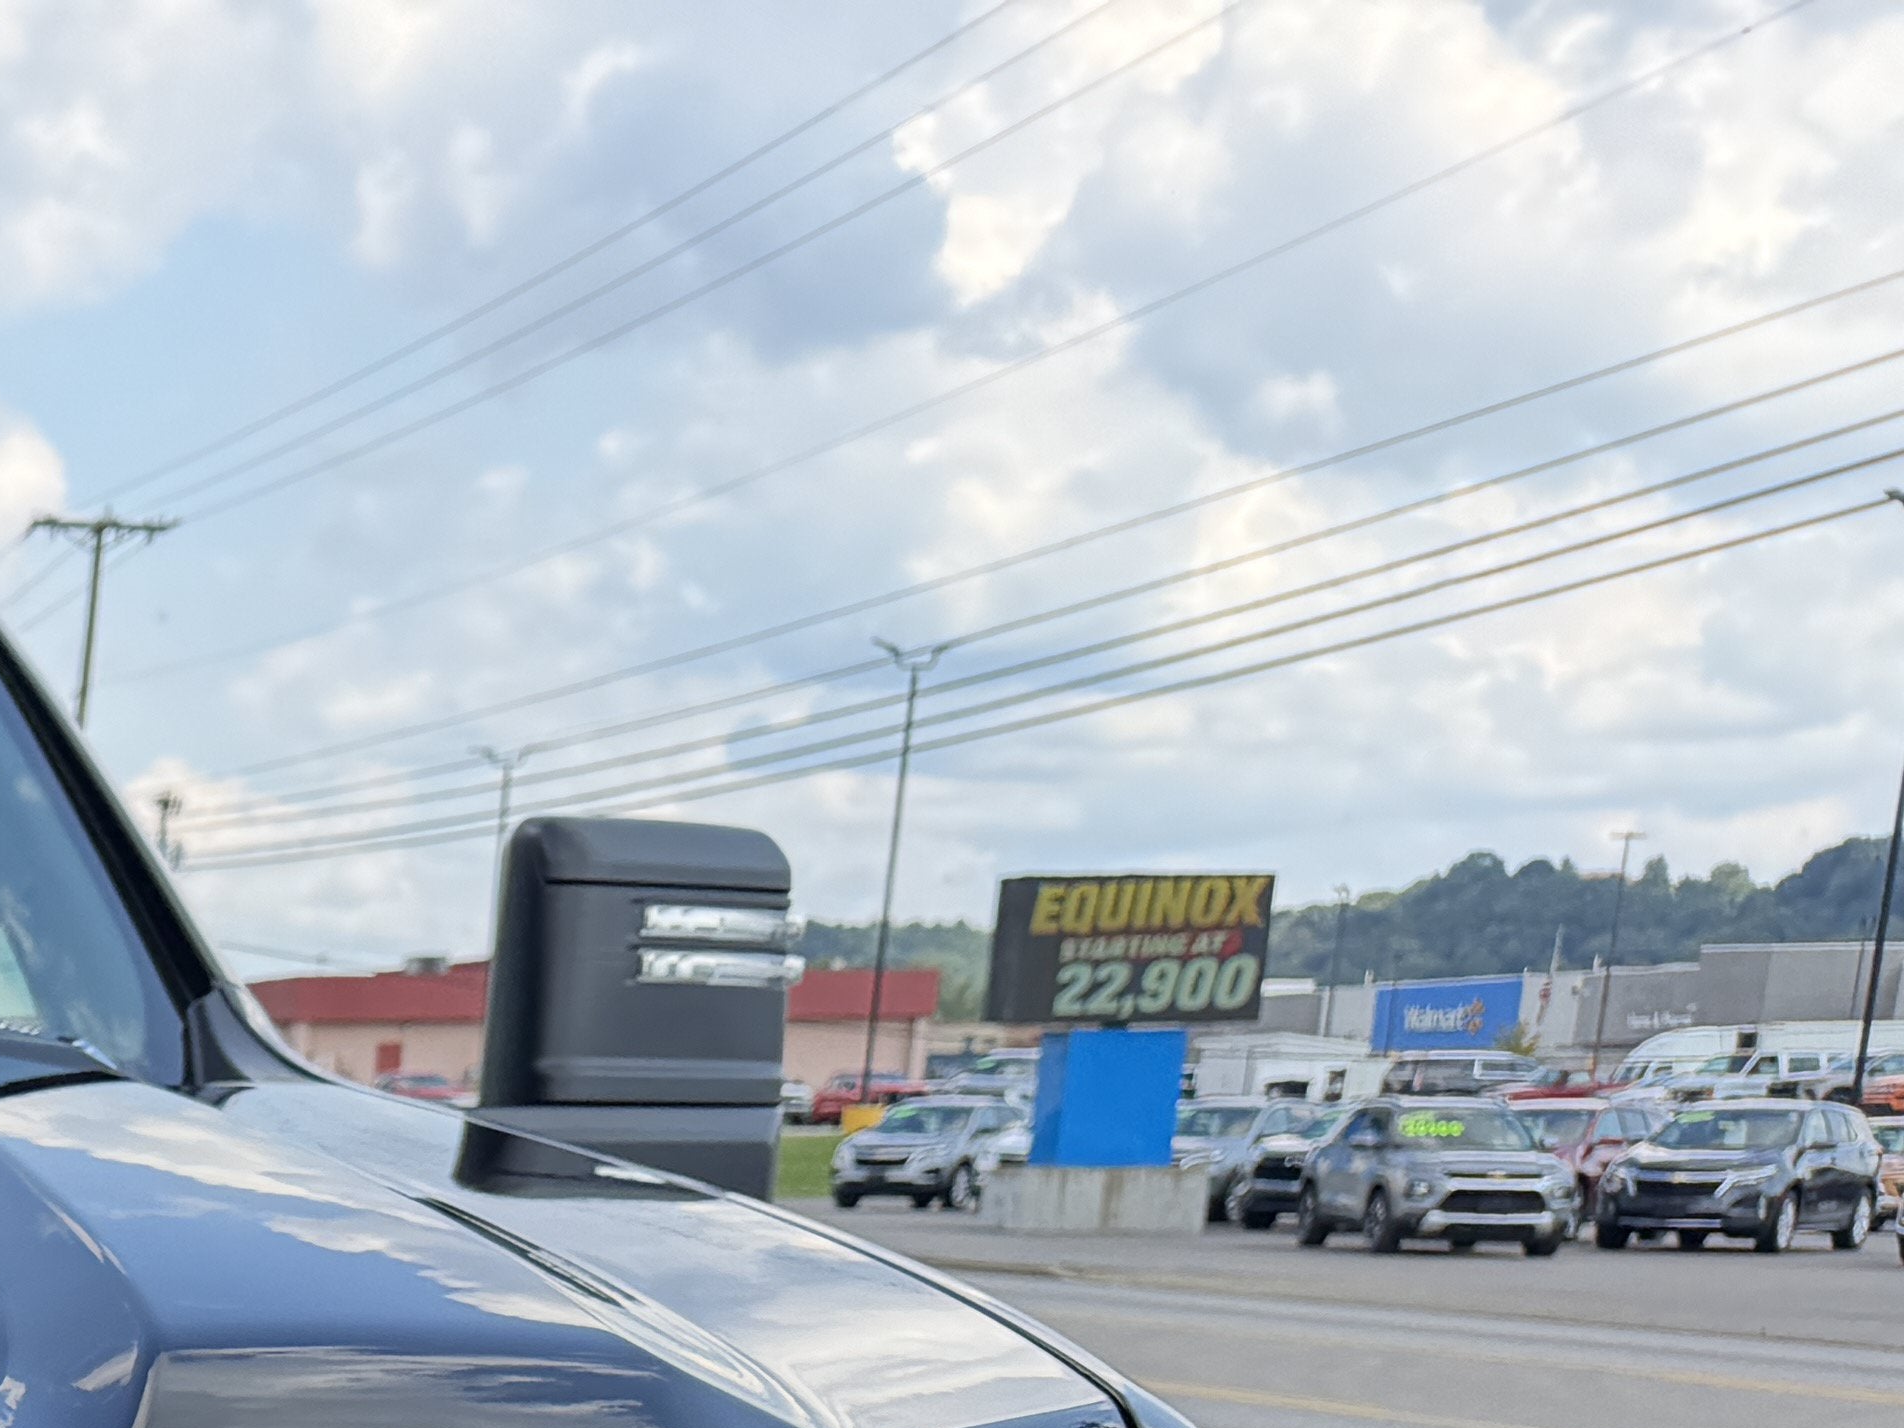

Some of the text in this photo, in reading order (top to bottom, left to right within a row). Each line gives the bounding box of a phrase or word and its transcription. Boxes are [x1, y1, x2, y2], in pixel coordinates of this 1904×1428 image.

[1028, 876, 1272, 937] EQUINOX
[1051, 953, 1260, 1021] 22,900
[1403, 1002, 1469, 1032] Walmart
